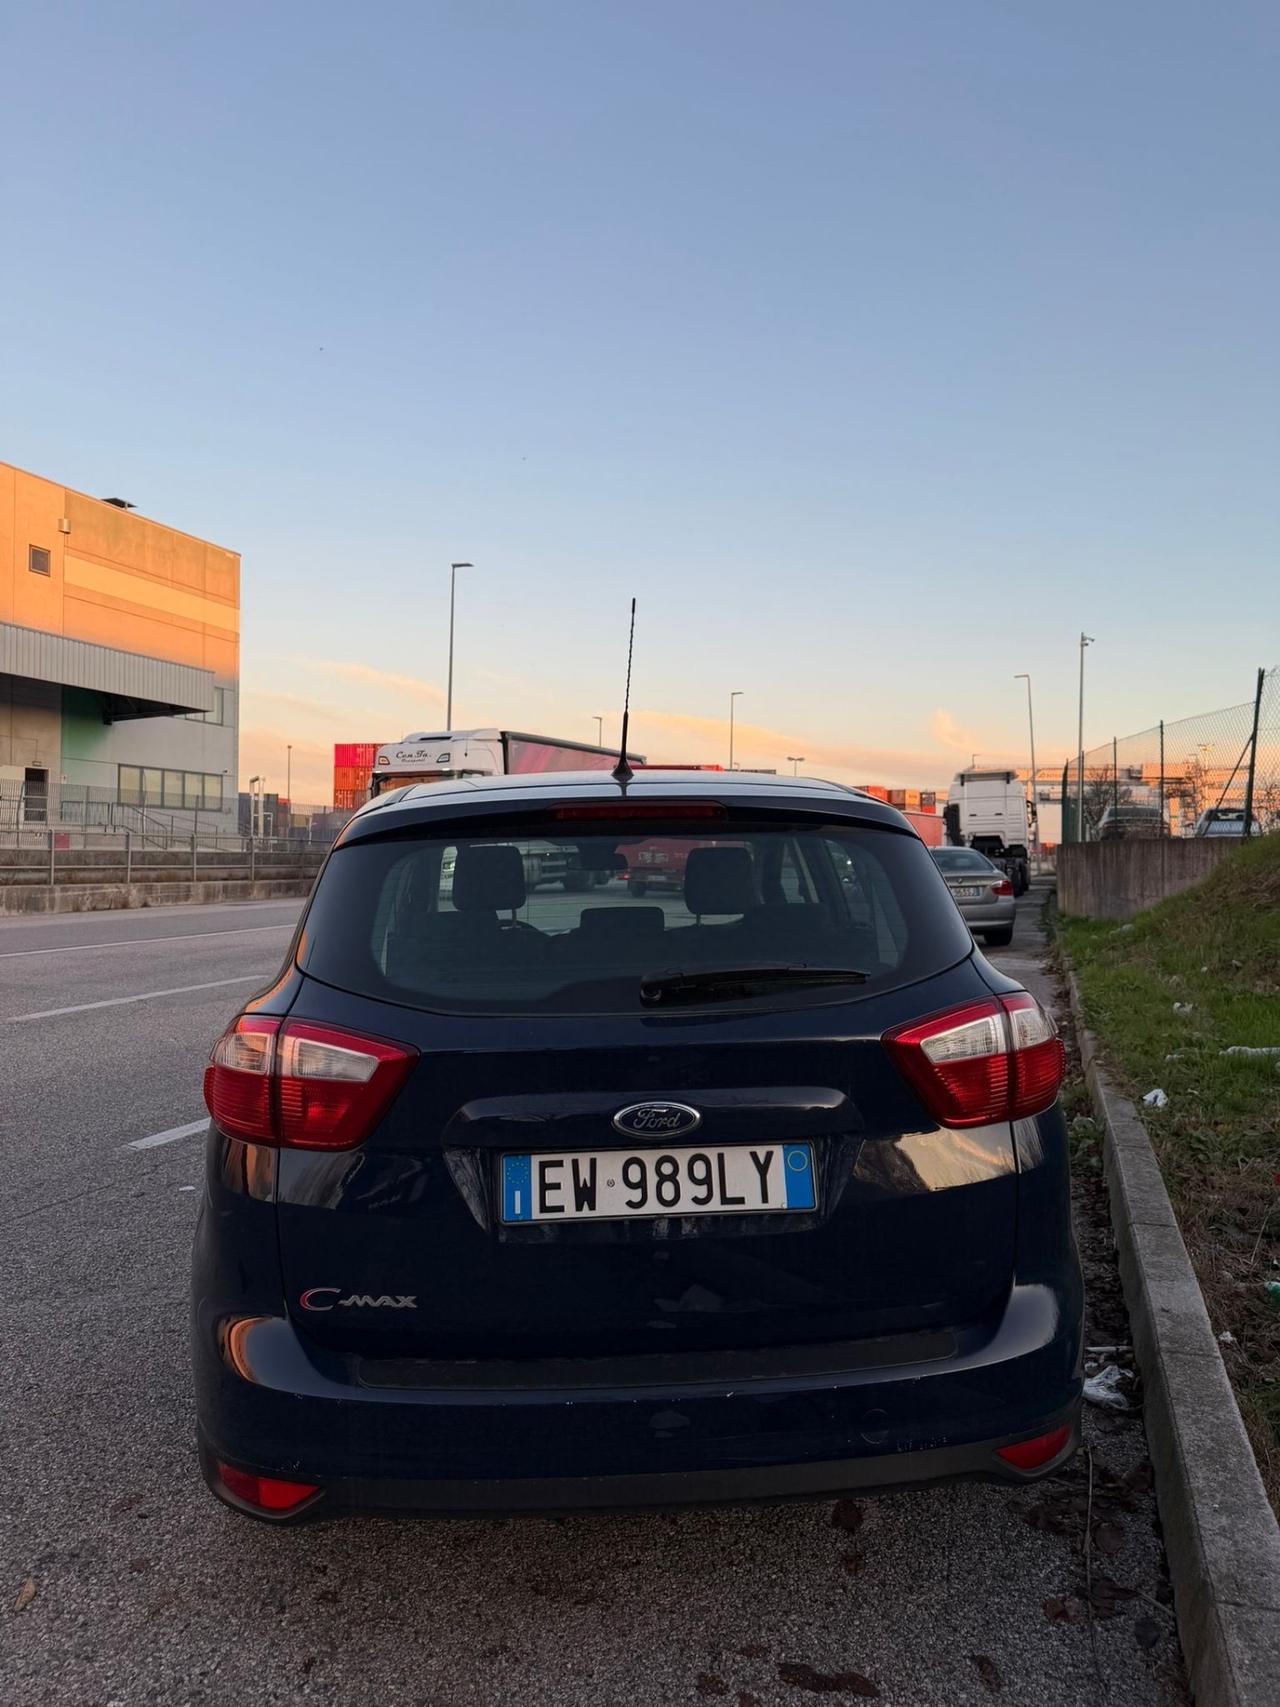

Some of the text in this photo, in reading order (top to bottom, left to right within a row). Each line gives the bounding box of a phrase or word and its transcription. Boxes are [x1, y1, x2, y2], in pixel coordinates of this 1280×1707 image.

[633, 1108, 681, 1129] Ford
[539, 1151, 773, 1214] EW 989LY
